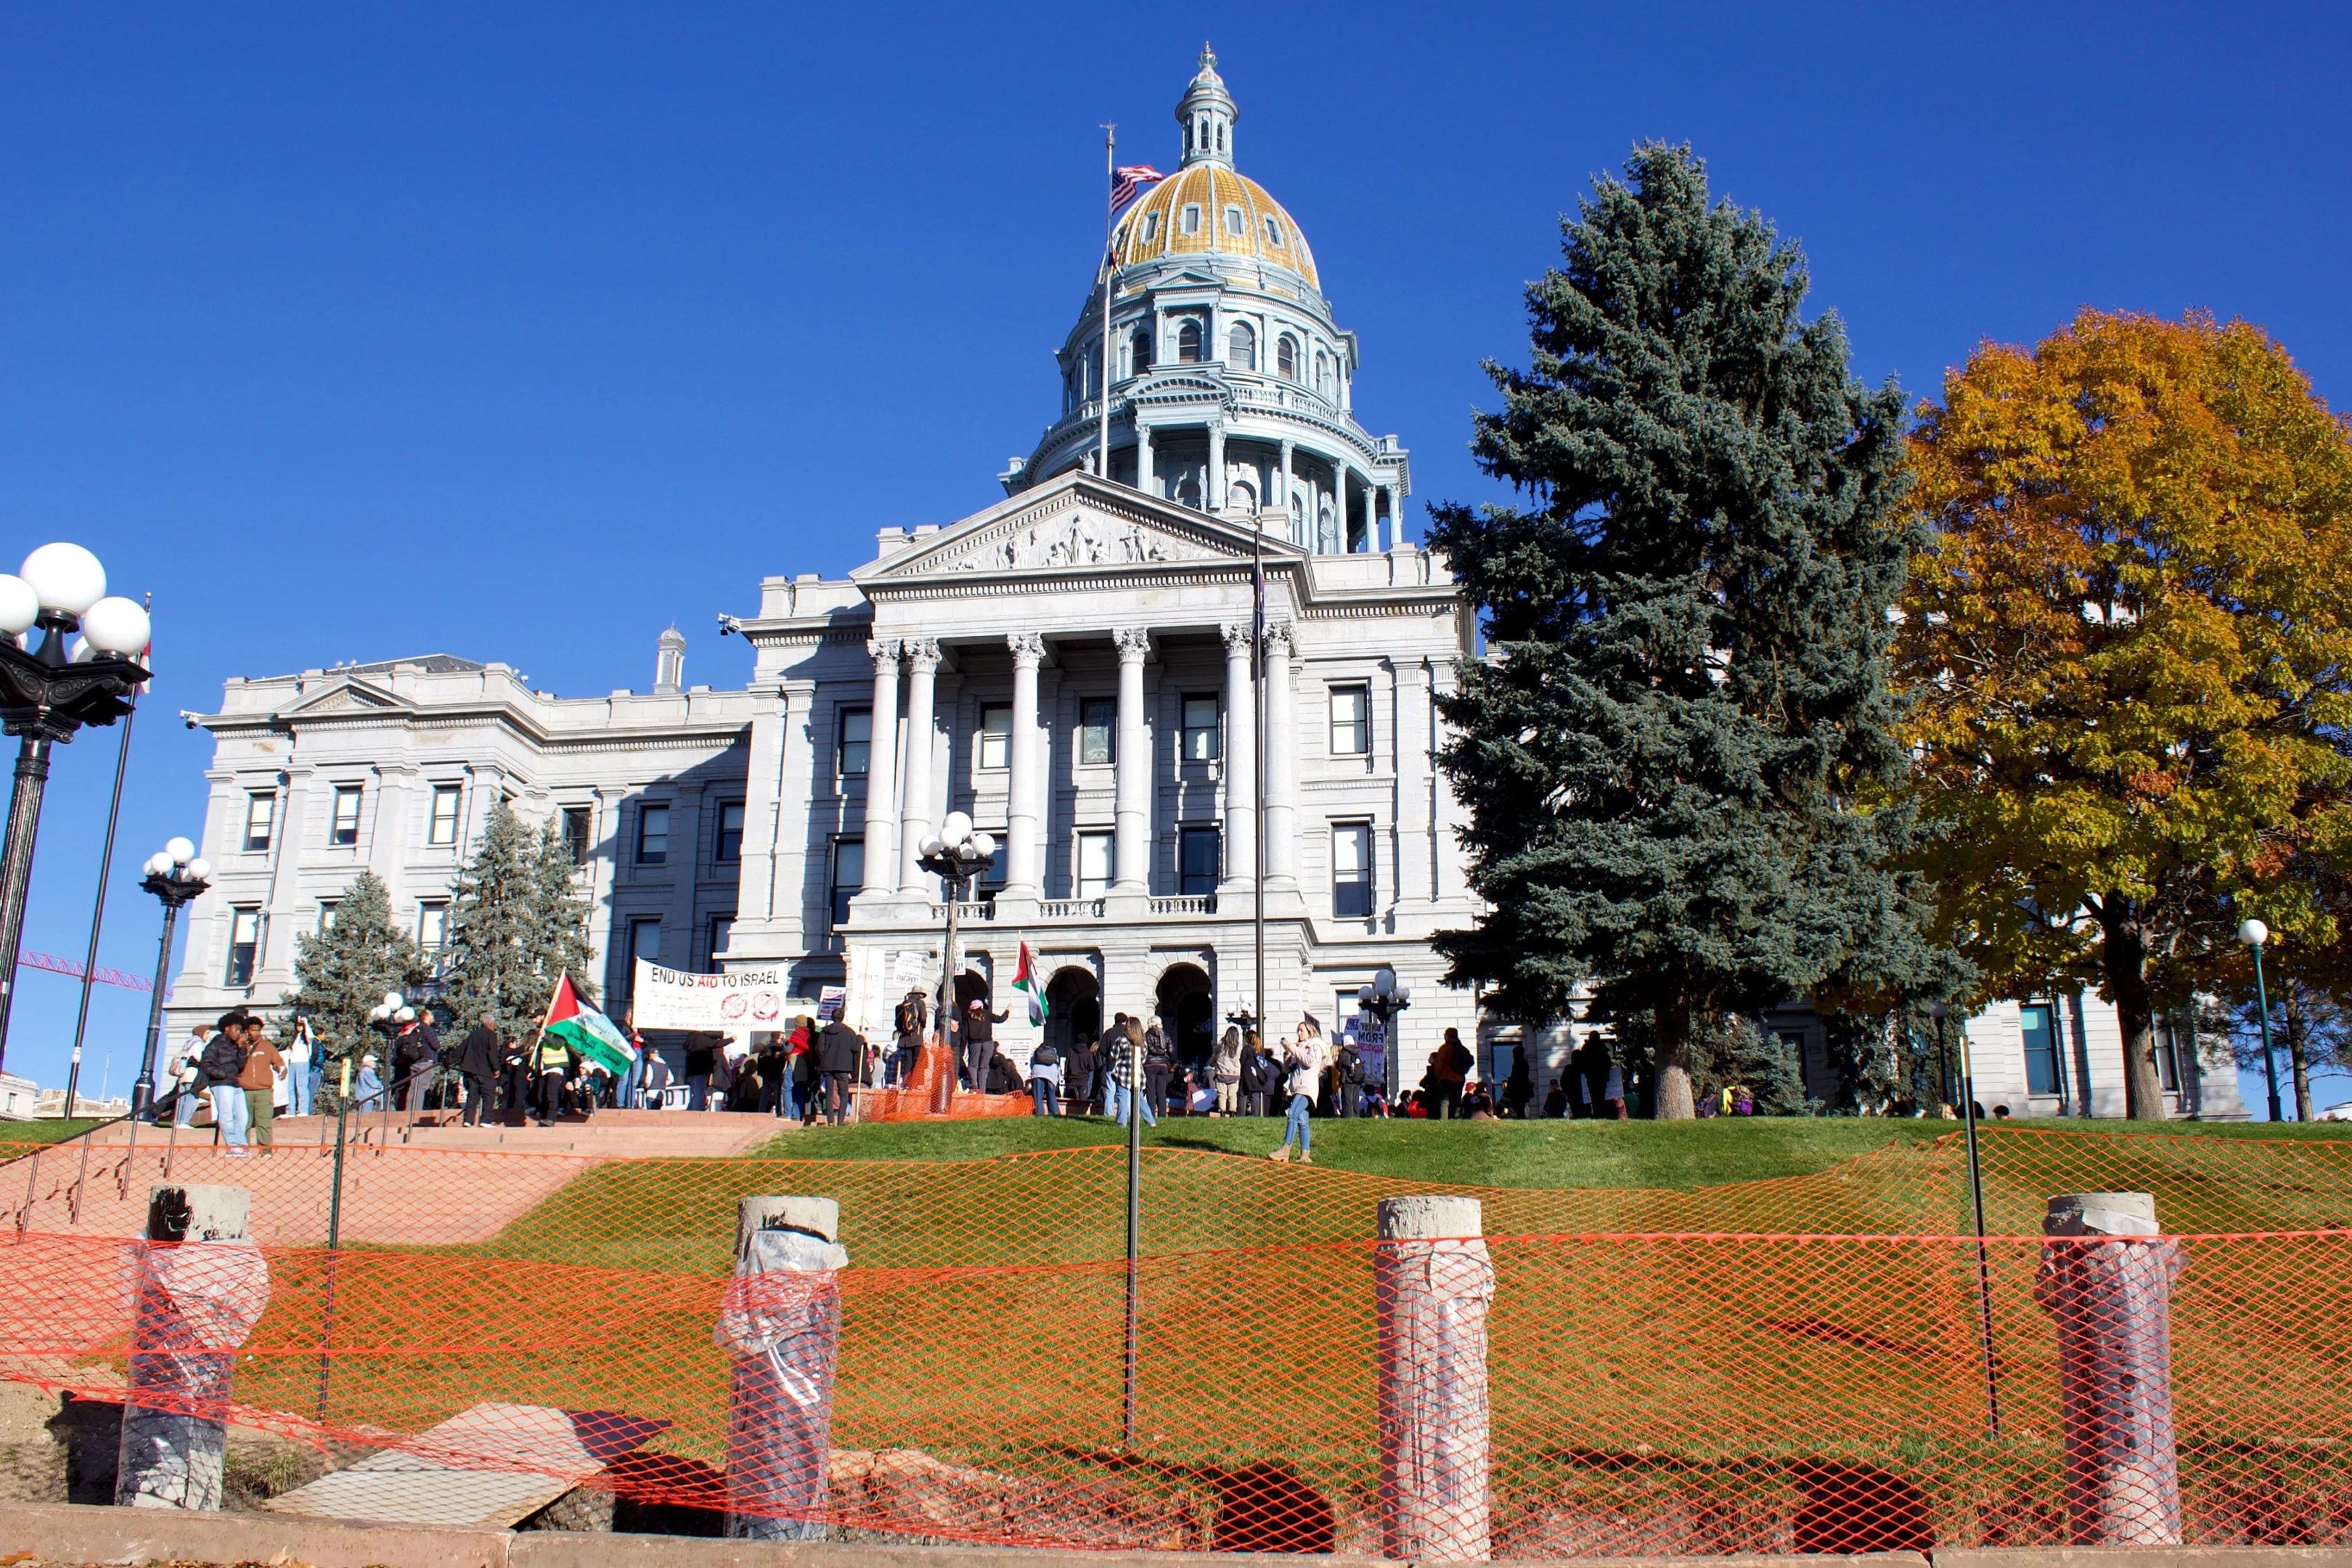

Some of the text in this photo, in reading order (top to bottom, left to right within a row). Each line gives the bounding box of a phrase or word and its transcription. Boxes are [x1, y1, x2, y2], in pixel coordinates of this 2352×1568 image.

[652, 967, 779, 988] END US AID TO ISRAEL
[1347, 1018, 1360, 1026] FREE
